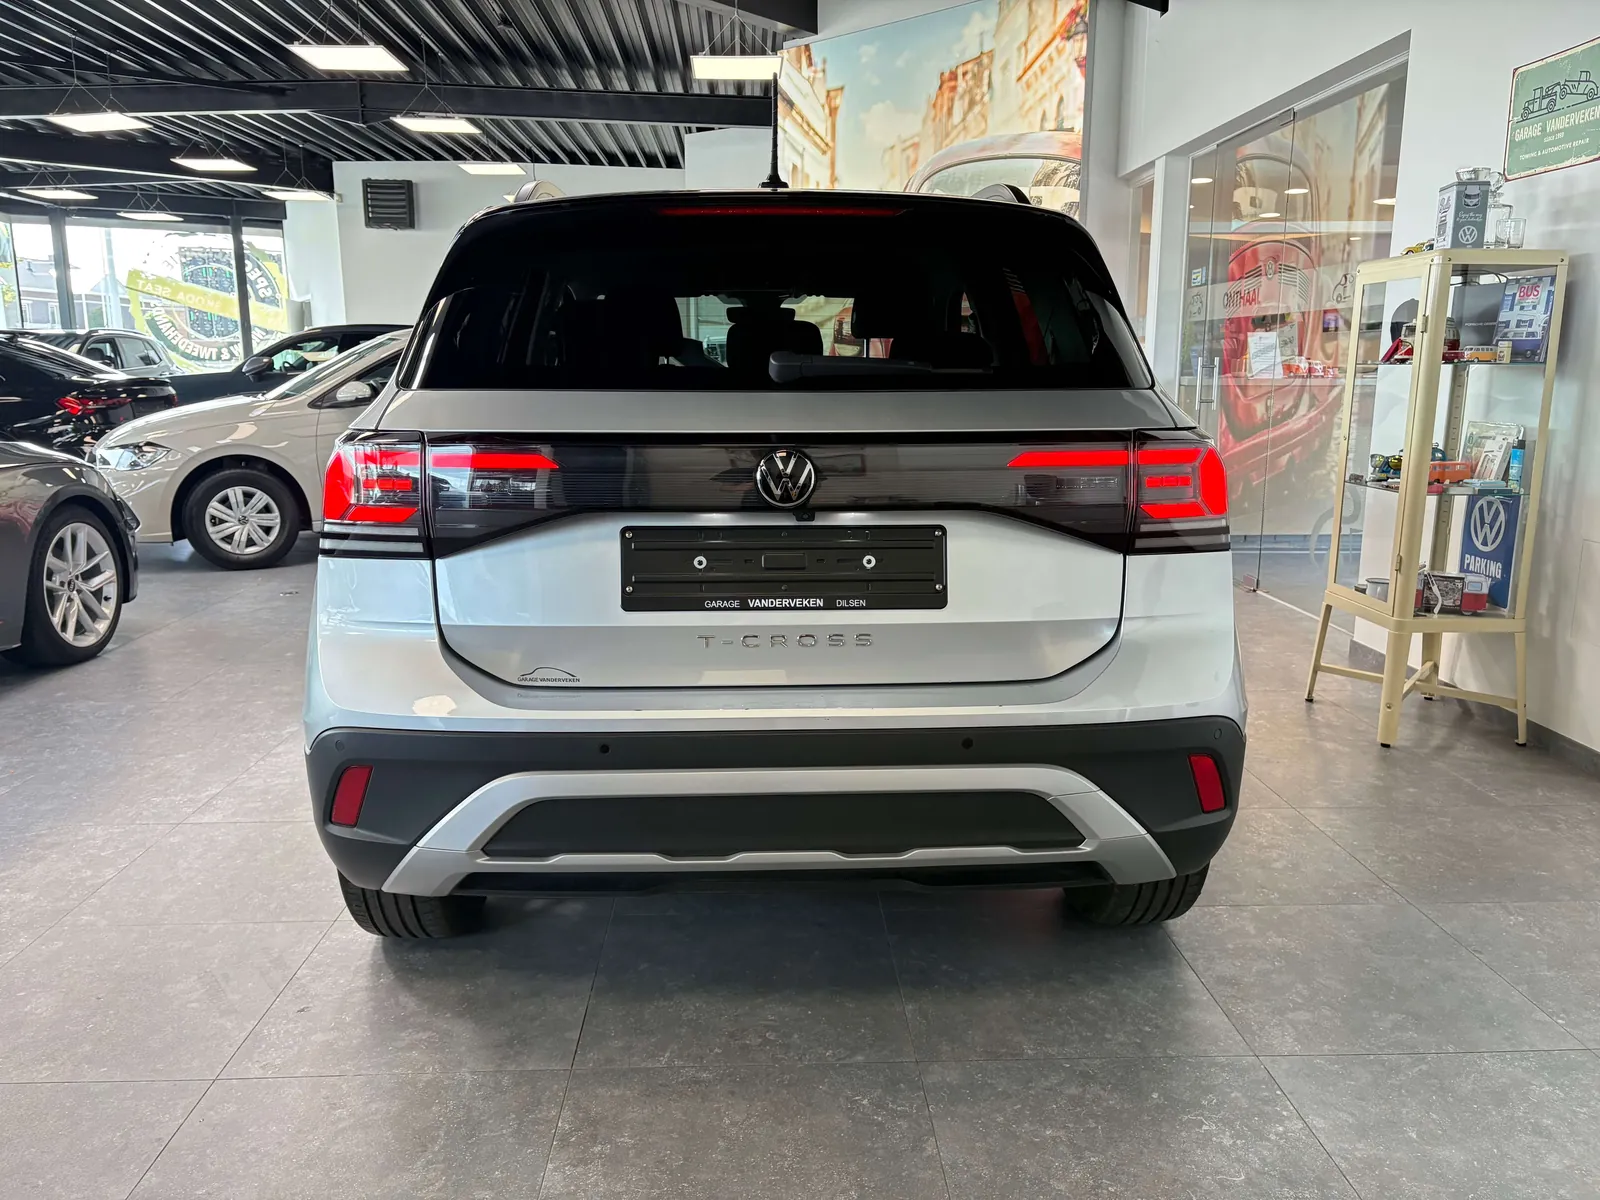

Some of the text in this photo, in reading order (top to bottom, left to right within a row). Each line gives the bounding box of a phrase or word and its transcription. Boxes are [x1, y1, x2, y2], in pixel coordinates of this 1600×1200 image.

[1514, 106, 1600, 142] GARAGE VANDERVEKEN
[1519, 149, 1537, 161] TOWING
[1541, 143, 1572, 154] AUTOMOTIVE
[1572, 137, 1590, 147] REPAIR
[1518, 284, 1540, 298] BUS
[1464, 553, 1502, 579] PARKING
[704, 598, 866, 608] GARAGE VANDERVEKEN DILSEN
[696, 633, 873, 649] T-CROSS
